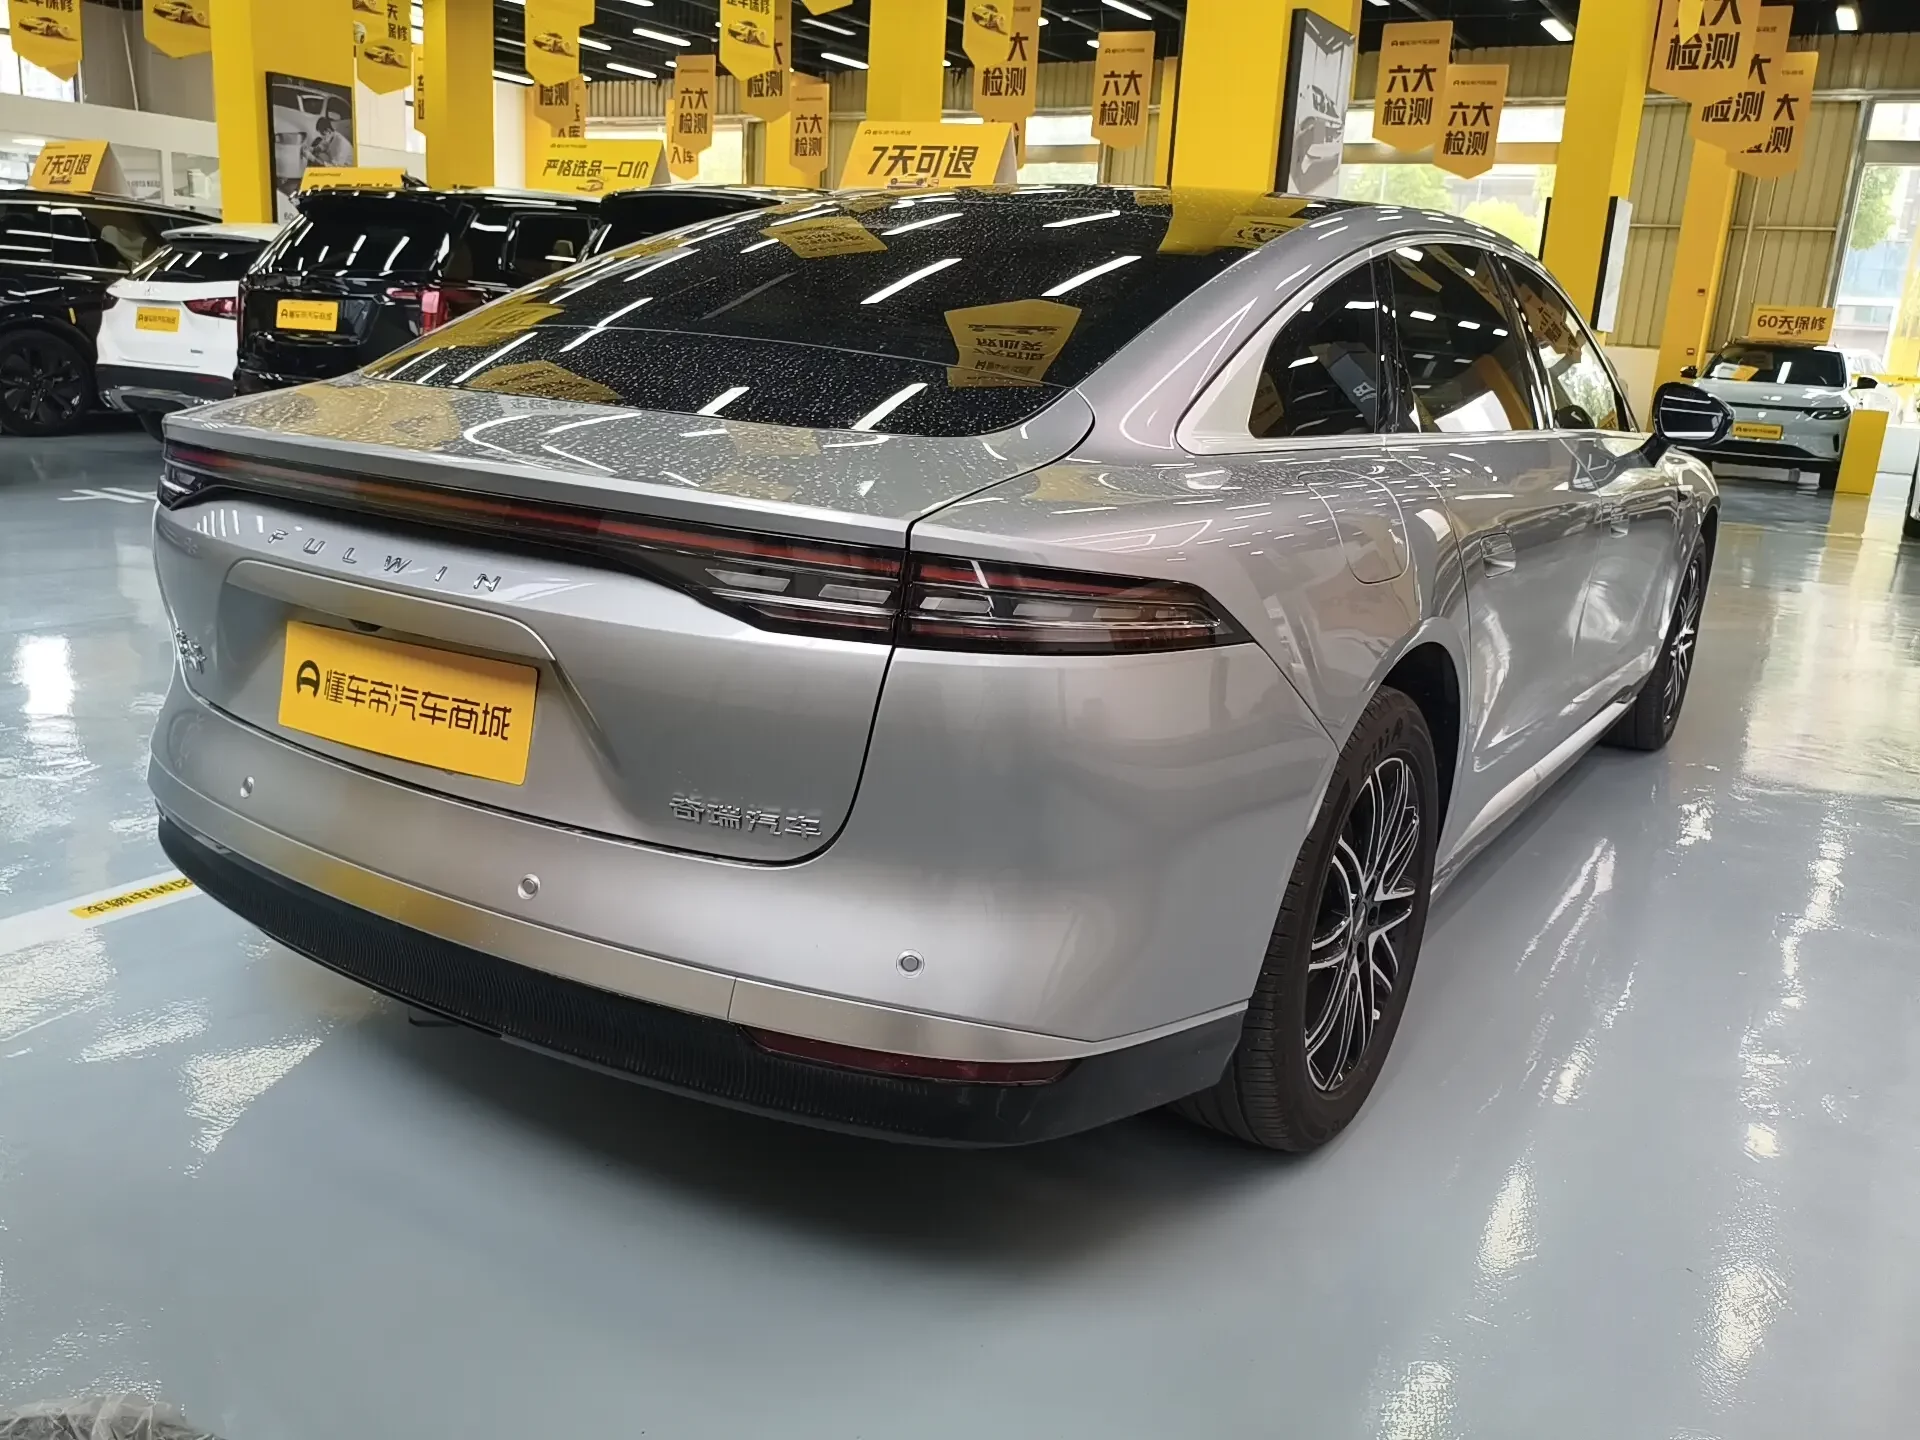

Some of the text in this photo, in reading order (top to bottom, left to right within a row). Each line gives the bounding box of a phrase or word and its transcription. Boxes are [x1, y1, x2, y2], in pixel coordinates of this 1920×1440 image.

[1007, 32, 1028, 61] 大
[1665, 32, 1740, 70] 检测
[747, 69, 783, 97] 检测
[981, 67, 1027, 96] 检测
[1102, 70, 1142, 96] 六大
[1386, 64, 1437, 93] 六大
[680, 88, 708, 109] 六大
[1382, 97, 1433, 126] 检测
[1702, 91, 1765, 122] 检测
[1774, 93, 1799, 121] 大
[679, 113, 708, 134] 检测
[796, 114, 822, 134] 六大
[1100, 100, 1140, 126] 检测
[1447, 102, 1493, 126] 六大
[794, 137, 822, 156] 检测
[1443, 131, 1489, 156] 检测
[42, 154, 92, 175] 7天可退
[542, 159, 649, 179] 严格选品一口价
[867, 145, 979, 178] 7天可退
[1757, 314, 1827, 331] 60天保修
[267, 528, 502, 592] FULWIN
[324, 669, 513, 741] 懂车帝汽车商城
[669, 798, 822, 840] 奇瑞汽车
